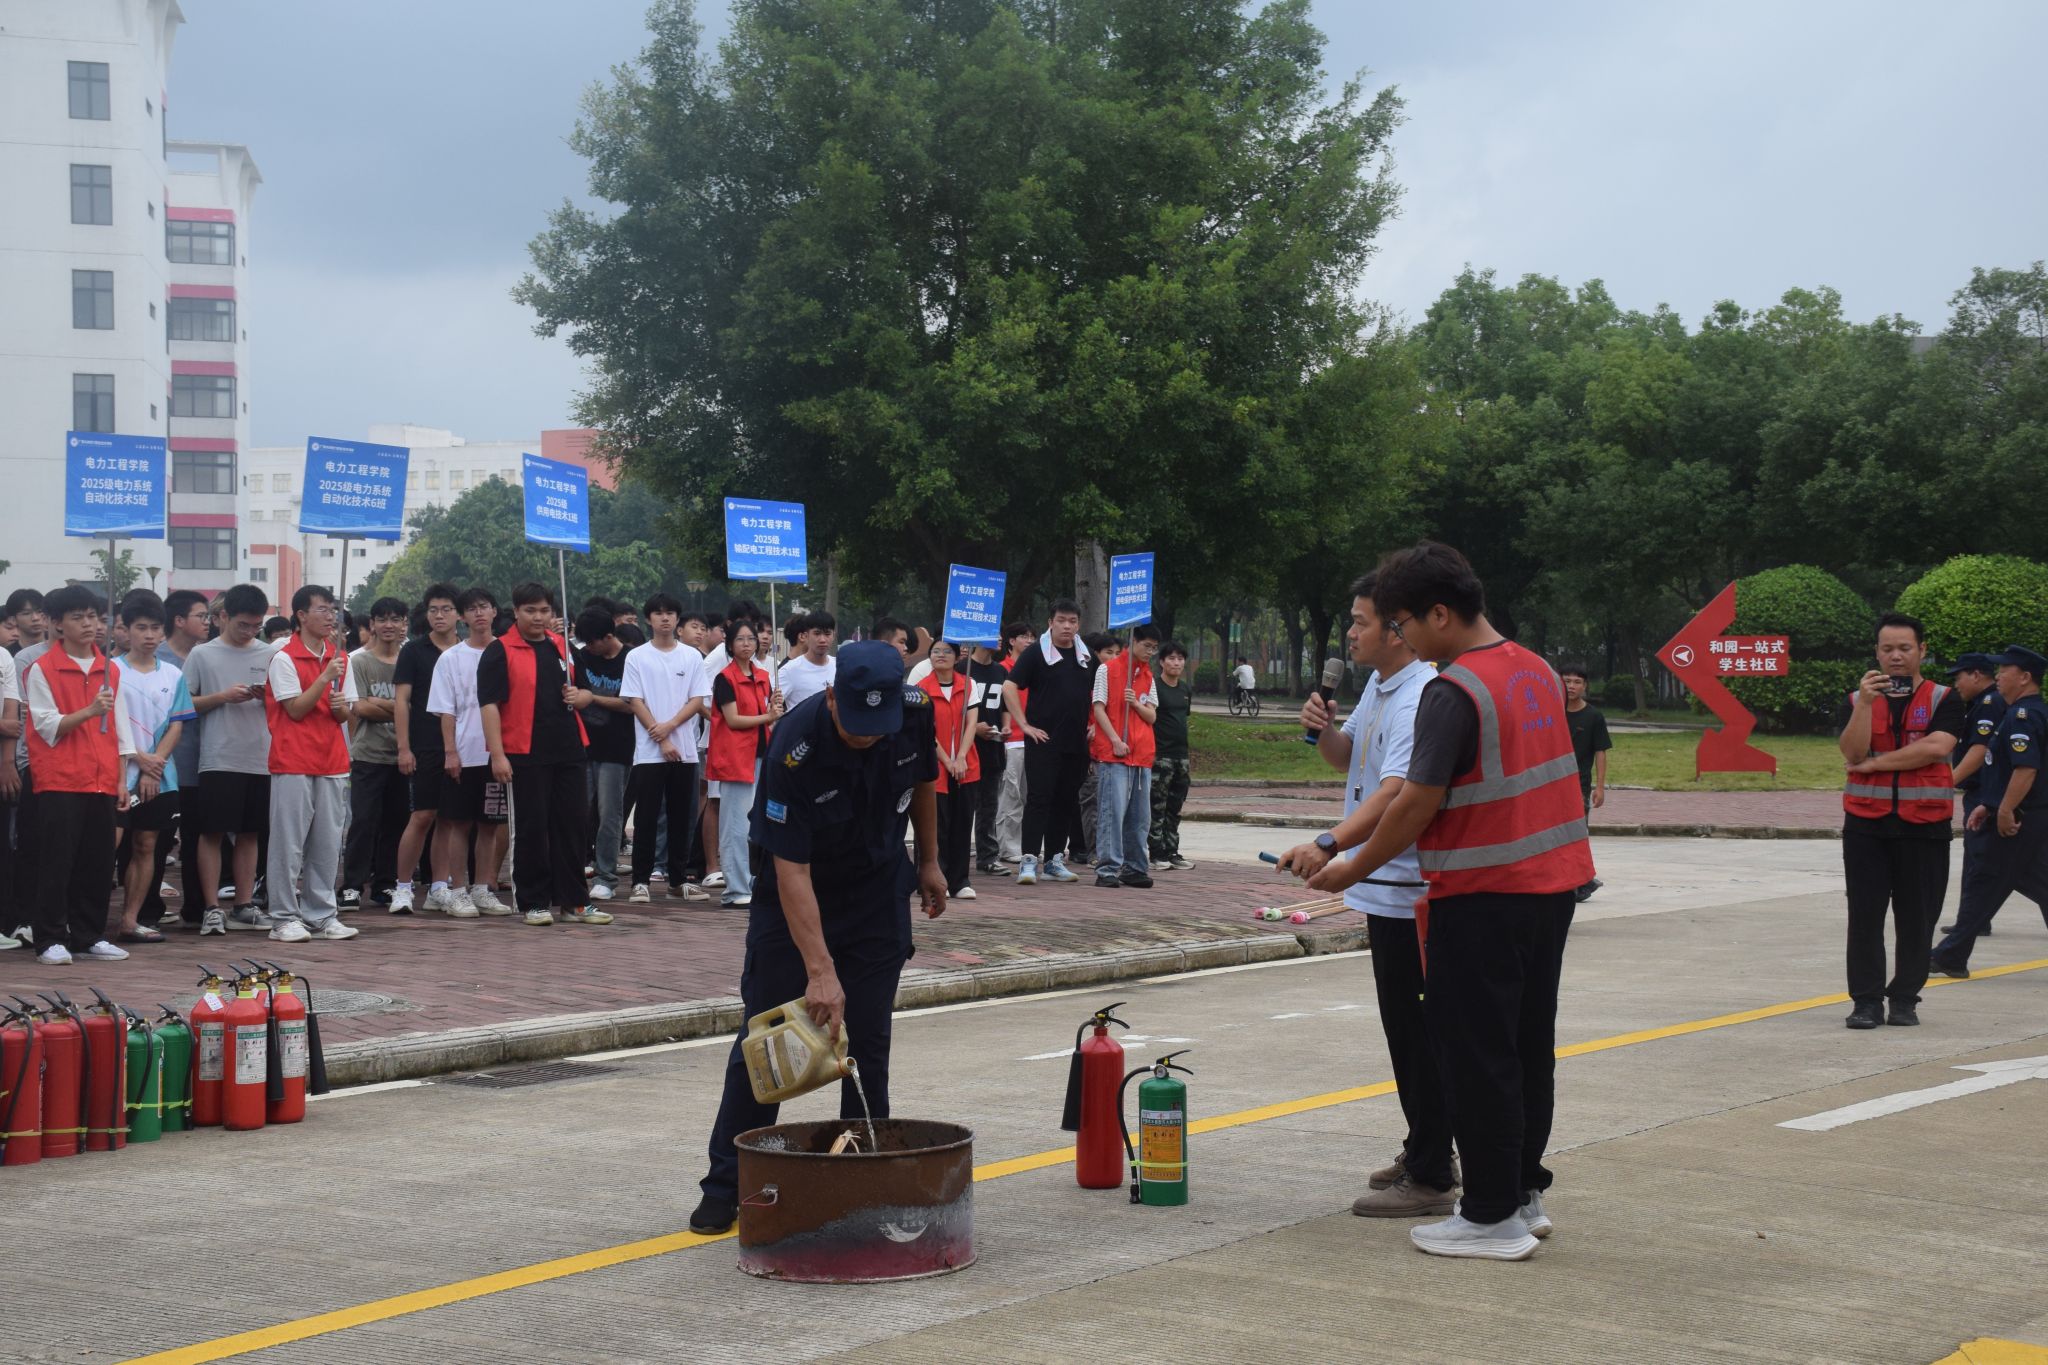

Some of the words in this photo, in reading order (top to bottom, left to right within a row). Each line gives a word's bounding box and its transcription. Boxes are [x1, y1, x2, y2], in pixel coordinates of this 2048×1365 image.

[85, 457, 149, 472] 电力工程学院
[325, 460, 391, 478] 电力工程学院
[81, 478, 152, 492] 2025级电力系统
[319, 480, 392, 497] 2025级电力系统
[535, 476, 577, 495] 电力工程学院
[85, 492, 149, 506] 自动化技术5班
[322, 493, 387, 509] 自动化技术6班
[545, 496, 568, 509] 2025级
[536, 505, 578, 523] 供用电技术1班
[741, 517, 791, 530] 电力工程学院
[754, 535, 780, 544] 2025级
[734, 543, 800, 557] 输配电工程技术1班
[1118, 570, 1147, 580] 电力工程学院
[959, 584, 995, 597] 电力工程学院
[966, 601, 985, 611] 2025级
[1709, 640, 1785, 654] 和园一站式
[1719, 658, 1778, 671] 学生社区
